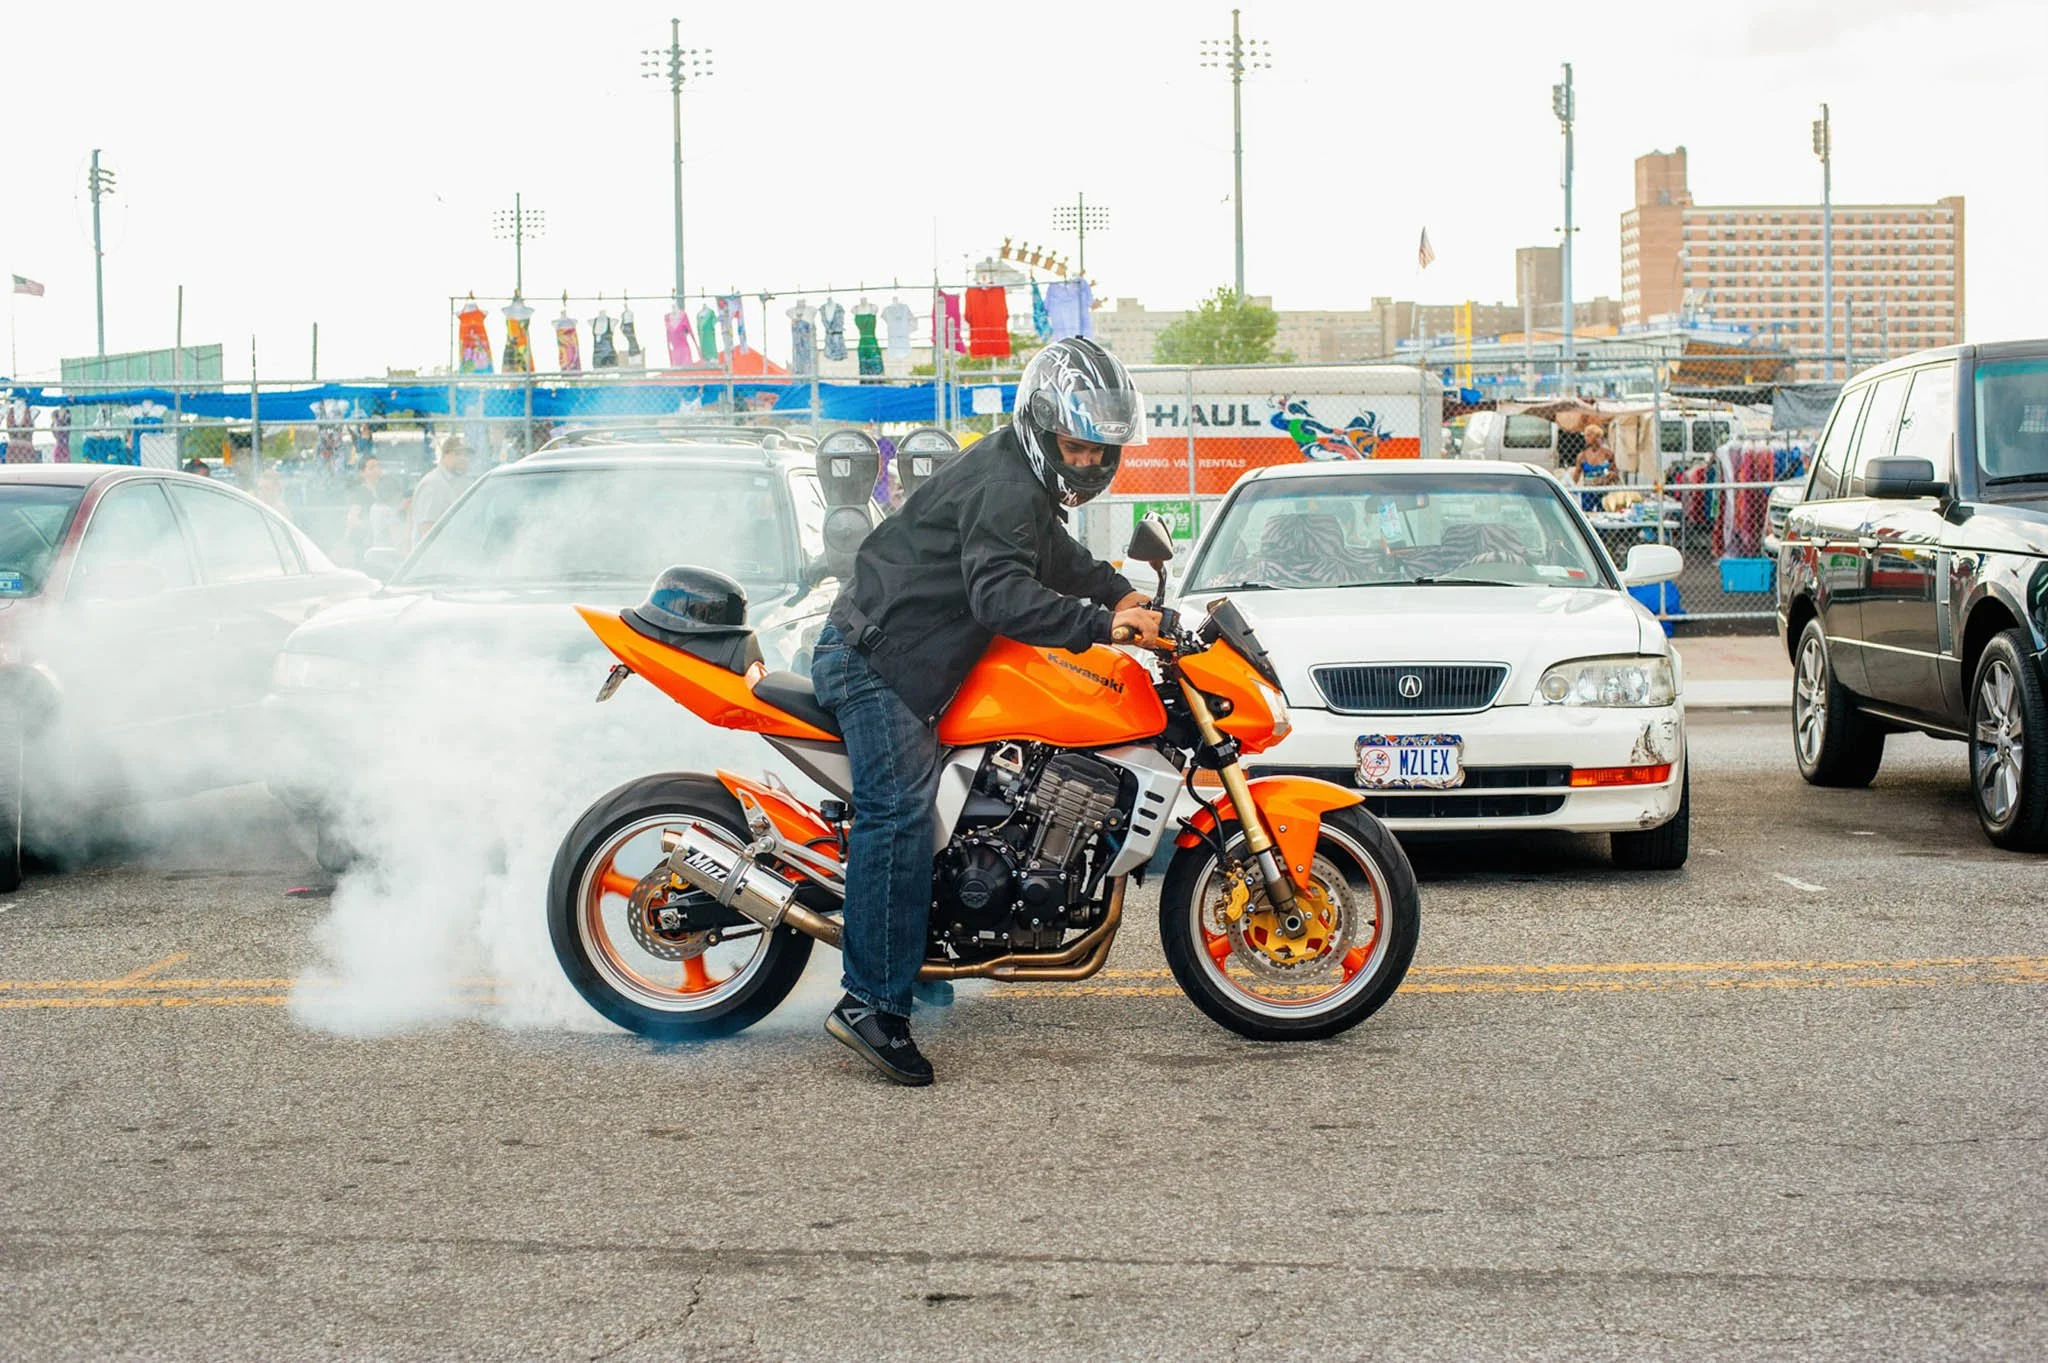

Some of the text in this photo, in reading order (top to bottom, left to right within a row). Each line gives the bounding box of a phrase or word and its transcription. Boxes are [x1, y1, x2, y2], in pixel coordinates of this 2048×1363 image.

[1146, 404, 1261, 427] -HAUL
[1125, 459, 1246, 468] MOVING VA RENTALS
[1047, 653, 1125, 694] Kawasaki
[1400, 749, 1449, 775] MZLEX
[682, 850, 746, 890] Muz
